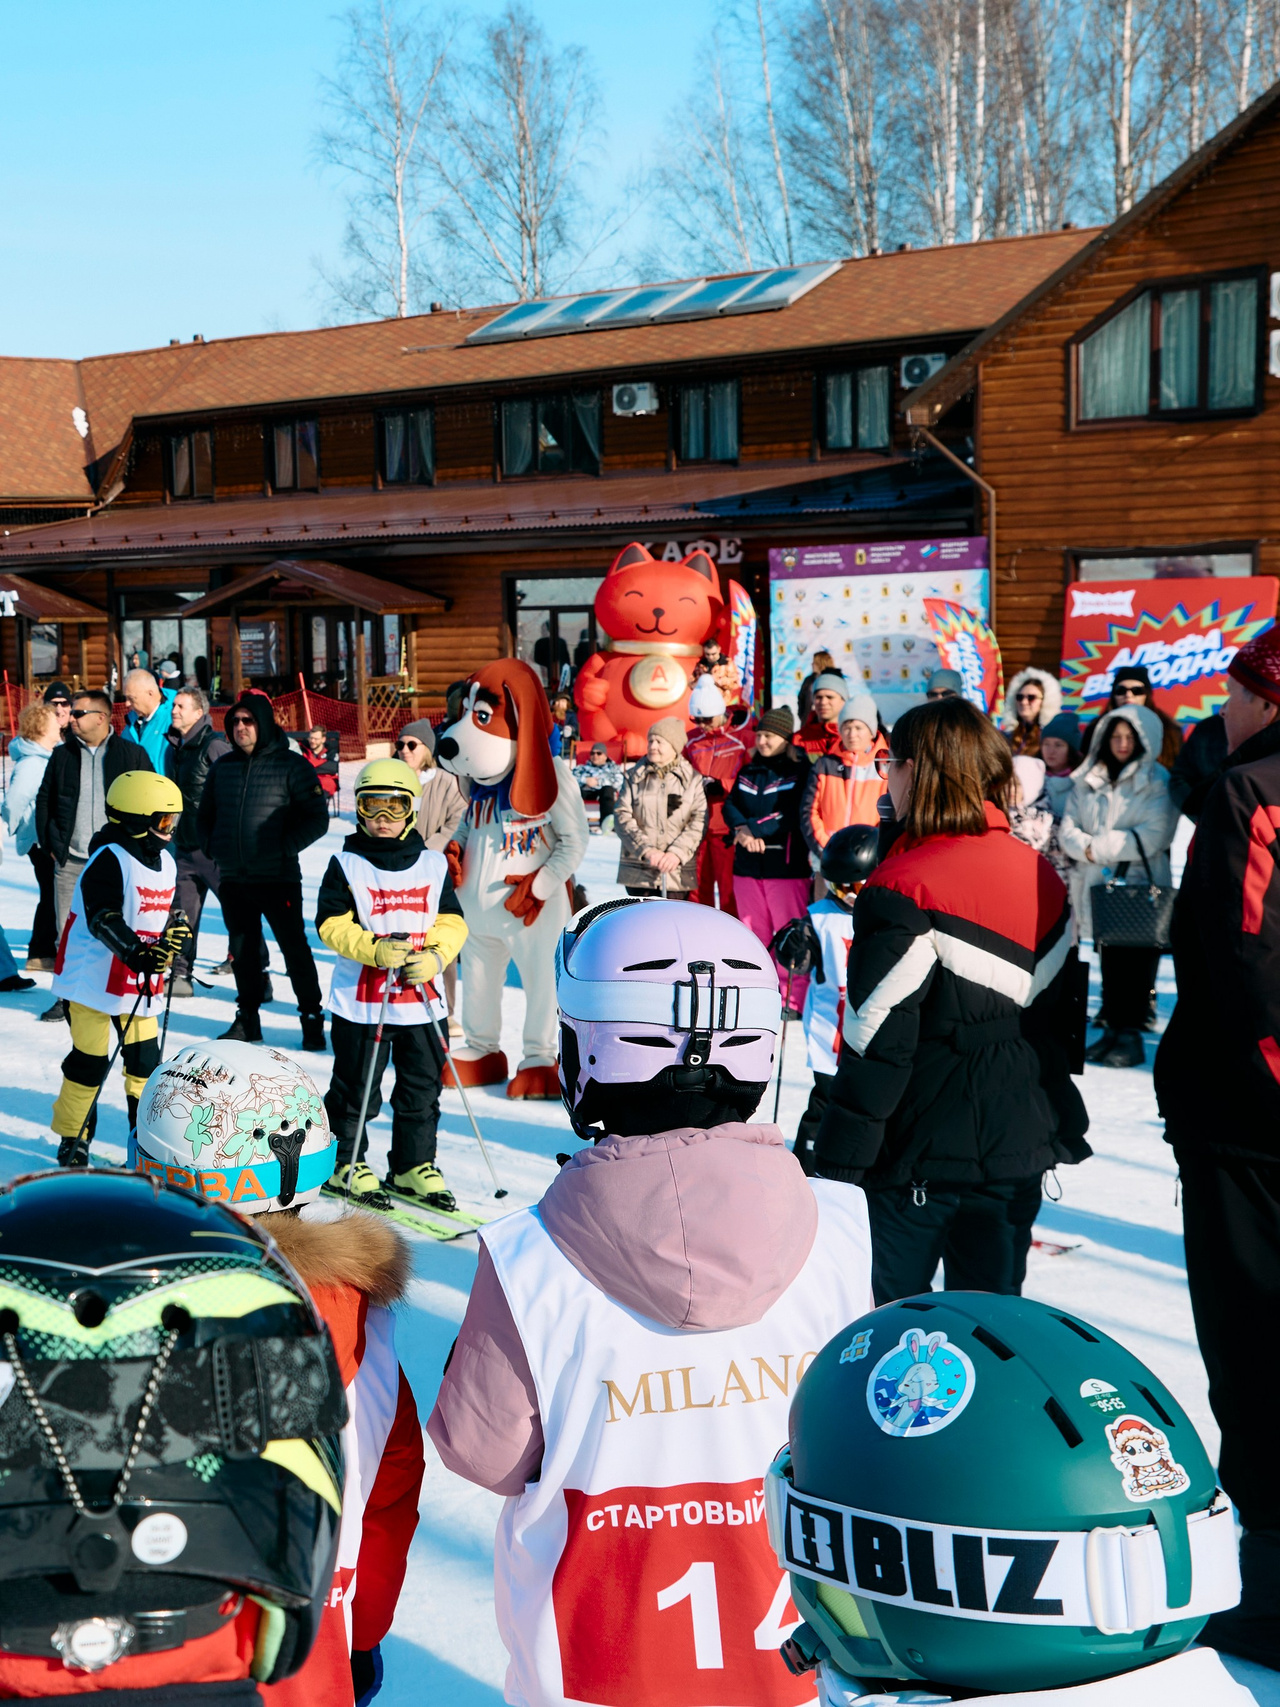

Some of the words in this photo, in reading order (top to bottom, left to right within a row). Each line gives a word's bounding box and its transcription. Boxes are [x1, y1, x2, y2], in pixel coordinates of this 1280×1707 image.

[642, 538, 744, 564] АФЕ
[1081, 645, 1239, 697] ВОДНО
[1106, 628, 1222, 671] АЛЬФА
[375, 895, 402, 906] Альфа
[403, 895, 425, 904] Банк
[160, 1069, 209, 1089] ALPINA
[586, 1489, 767, 1533] СТАРТОВЫЙ
[851, 1514, 1065, 1617] BLIZ
